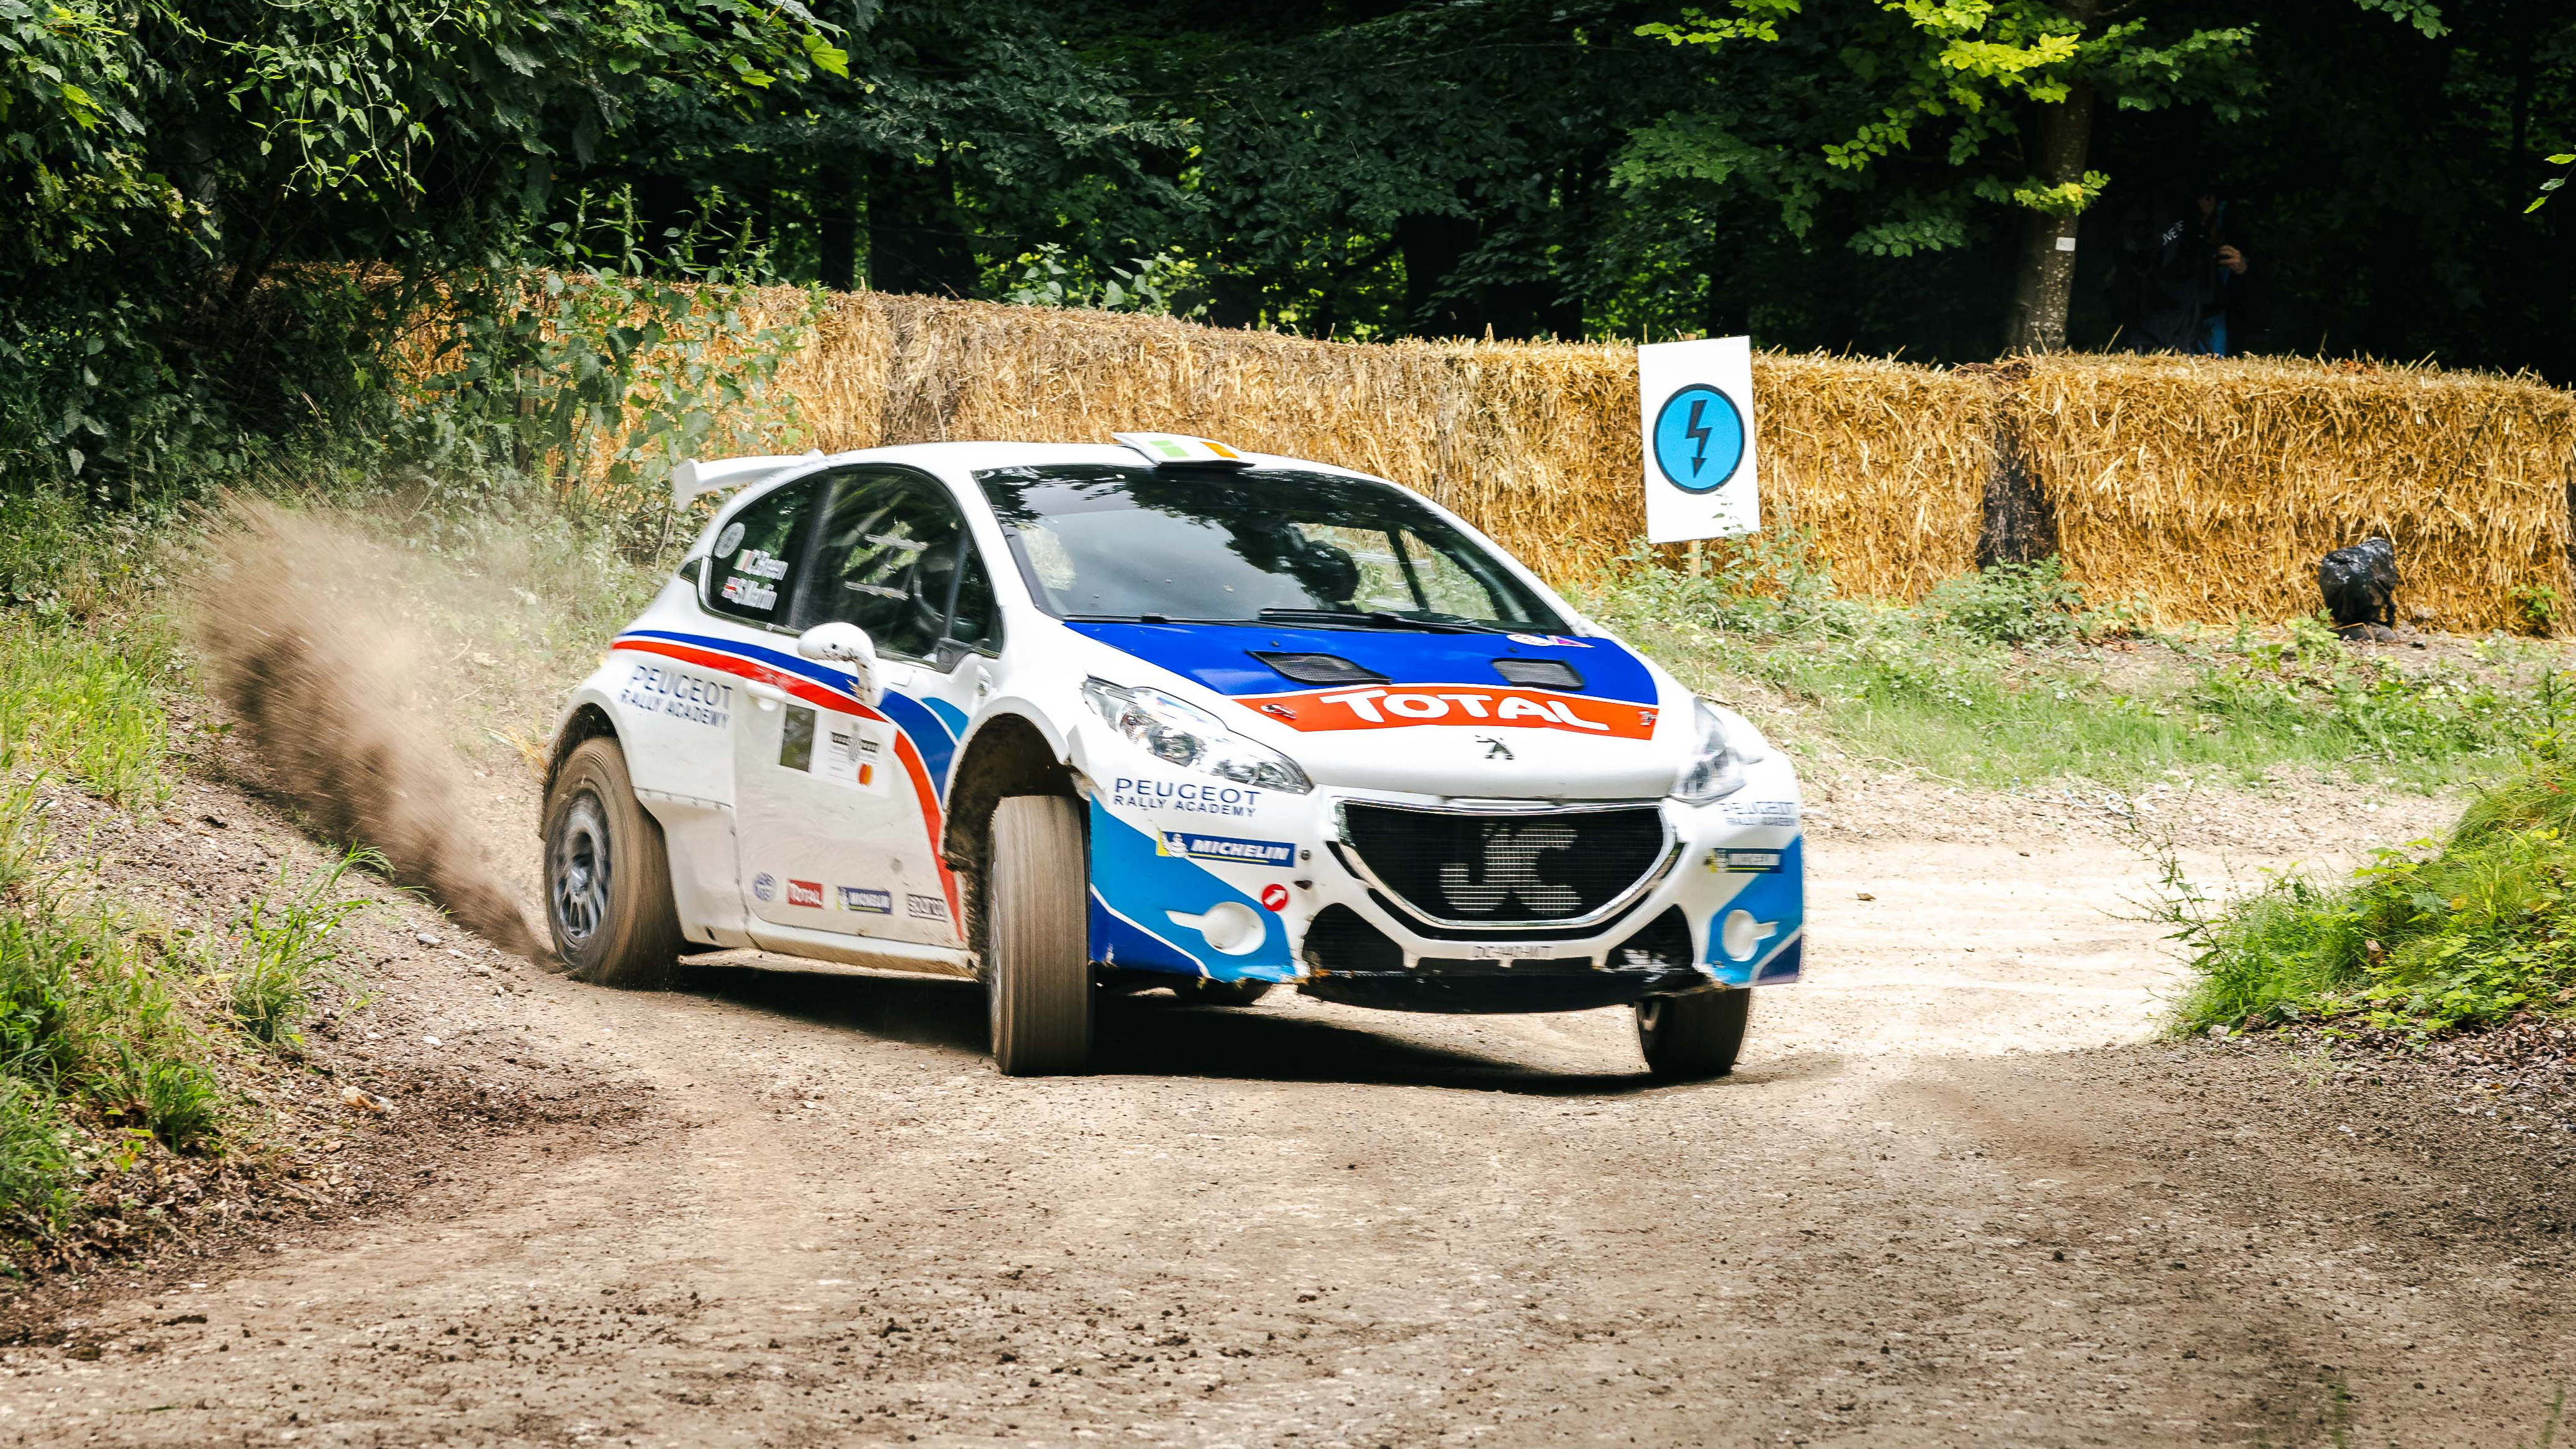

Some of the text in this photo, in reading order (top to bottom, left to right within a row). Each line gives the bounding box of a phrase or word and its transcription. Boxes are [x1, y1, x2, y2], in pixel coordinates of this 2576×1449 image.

[628, 665, 733, 709] PEUGEOT
[1320, 689, 1610, 731] TOTAL
[1113, 794, 1256, 817] RALLY ACADEMY
[1115, 778, 1261, 806] PEUGEOT
[1190, 839, 1290, 860] MICHELIN
[1439, 824, 1581, 916] JC
